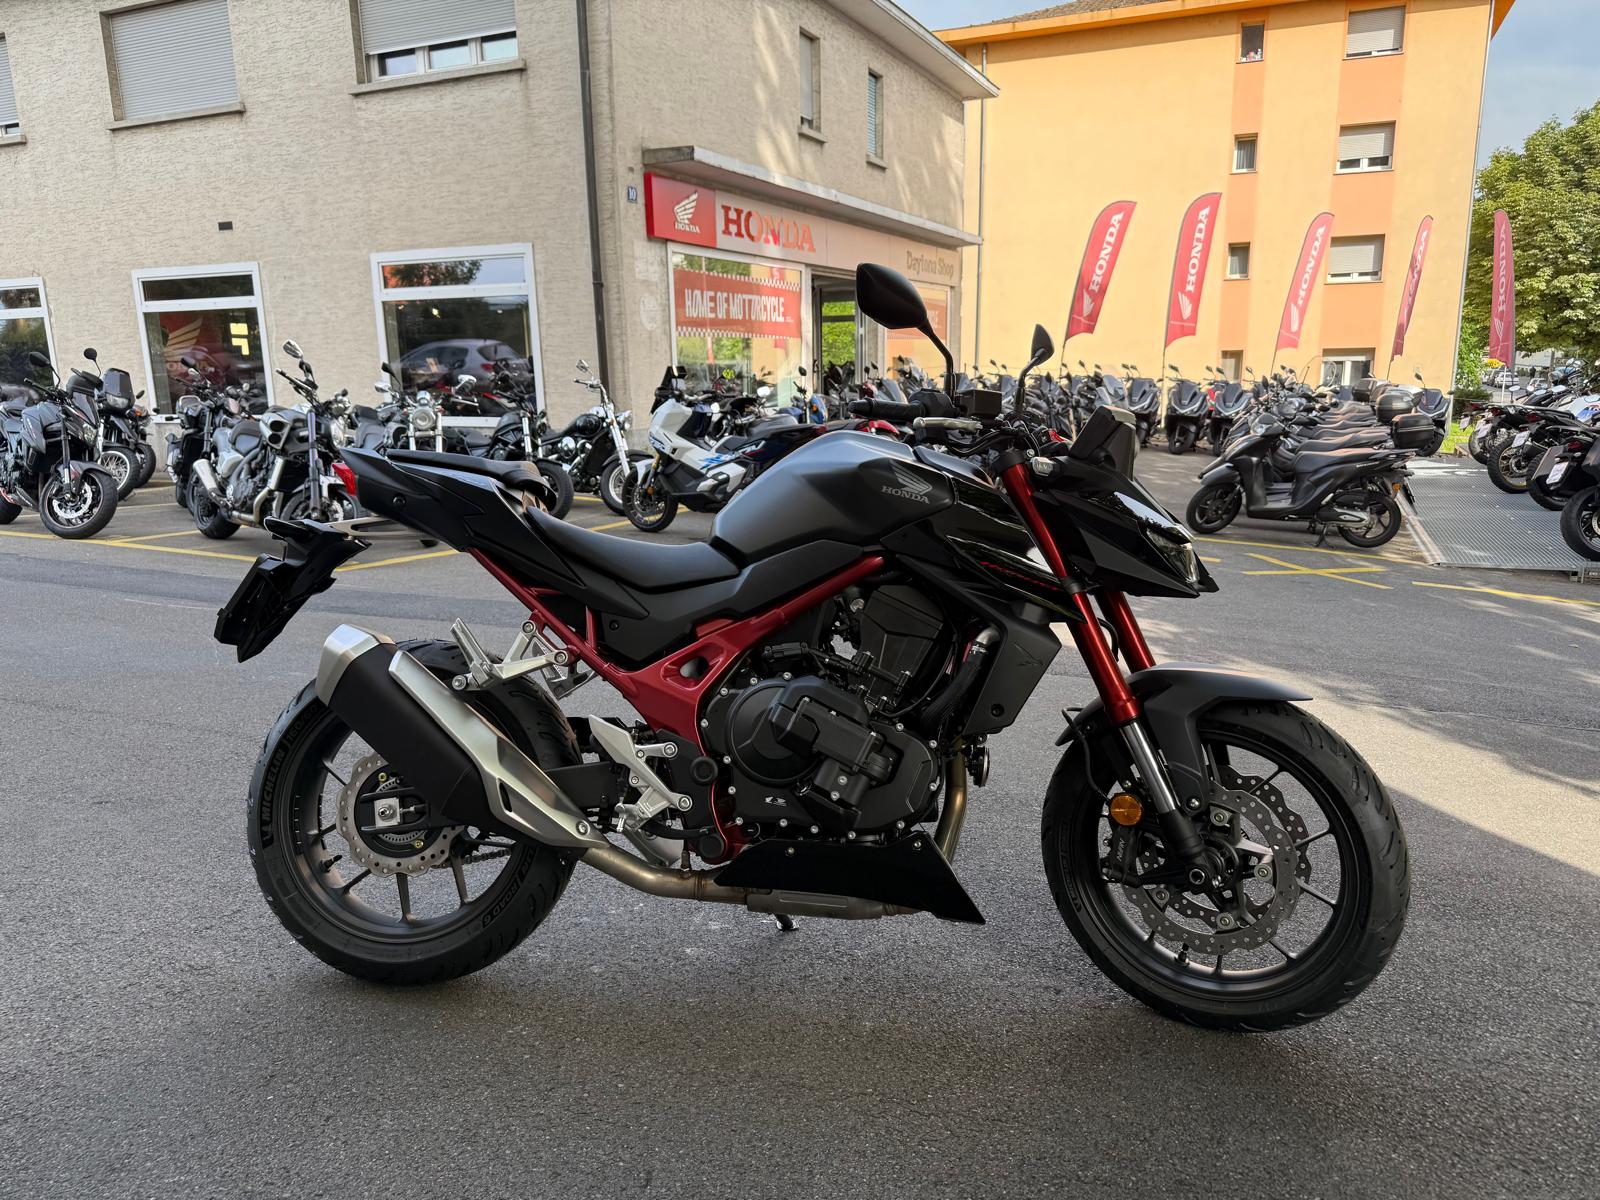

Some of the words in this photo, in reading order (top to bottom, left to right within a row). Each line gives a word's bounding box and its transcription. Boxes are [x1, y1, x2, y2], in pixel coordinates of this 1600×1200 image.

[674, 221, 700, 234] HONDA
[721, 204, 816, 253] HONDA
[1088, 211, 1124, 293] HONDA
[1185, 205, 1210, 293] HONDA
[906, 250, 937, 275] Daytona
[938, 256, 954, 280] Shop
[1297, 225, 1326, 306] HONDA
[1498, 219, 1506, 312] HONDA
[717, 291, 728, 320] OF
[881, 485, 930, 505] HONDA
[261, 746, 286, 821] MICHELIN
